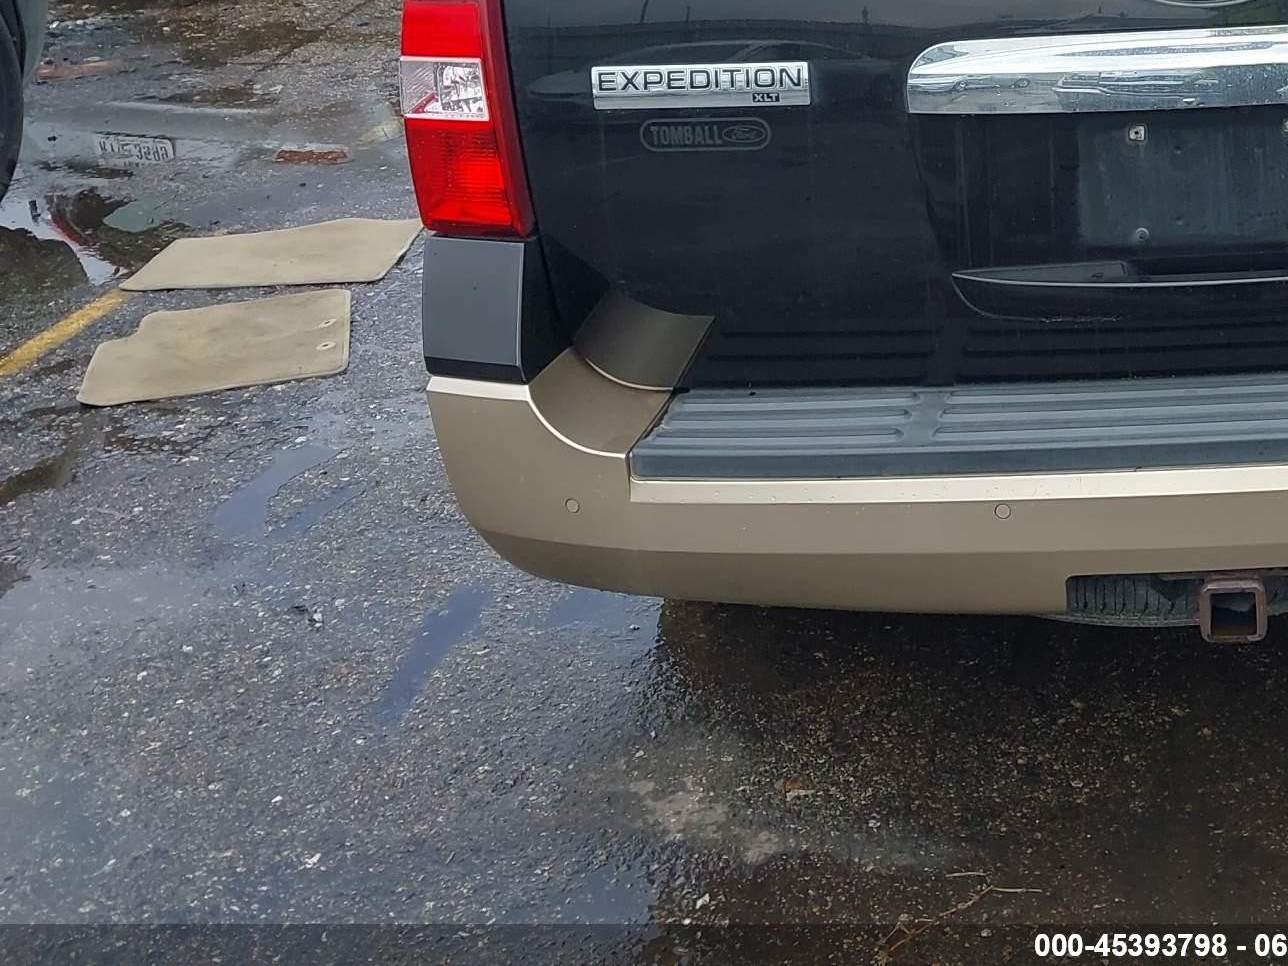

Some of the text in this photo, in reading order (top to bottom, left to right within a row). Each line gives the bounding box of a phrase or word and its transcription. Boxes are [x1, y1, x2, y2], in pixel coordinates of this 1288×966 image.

[597, 67, 802, 92] EXPEDITION
[753, 93, 779, 102] XLT
[650, 125, 758, 146] TOMBALL Ford
